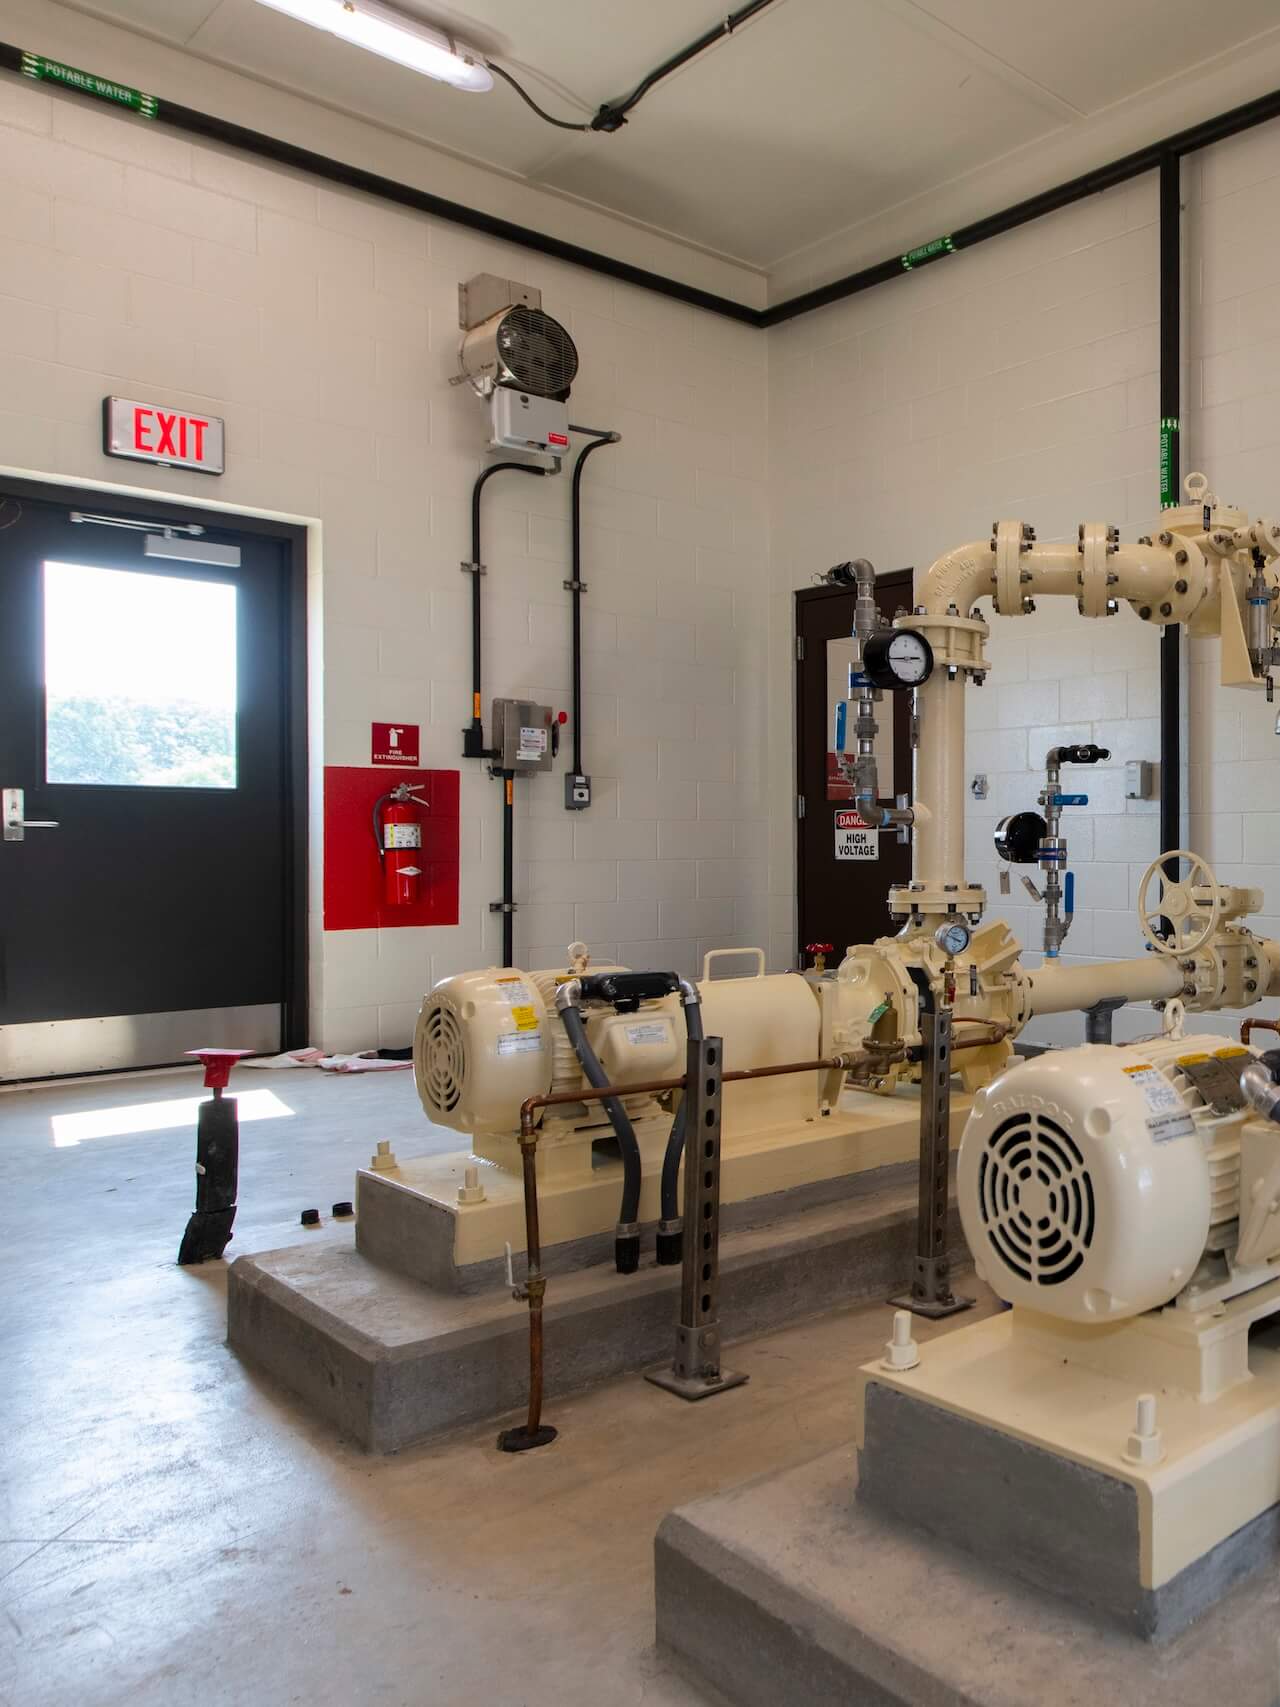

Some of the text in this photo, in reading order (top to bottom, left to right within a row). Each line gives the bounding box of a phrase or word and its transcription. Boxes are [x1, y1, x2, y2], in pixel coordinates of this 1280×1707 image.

[45, 62, 132, 103] POTABLE WATER
[134, 407, 209, 462] EXIT
[1161, 433, 1169, 494] POTABLE WATER
[839, 815, 868, 826] DANG
[838, 845, 876, 856] VOLTAGE
[846, 833, 867, 844] HIGH
